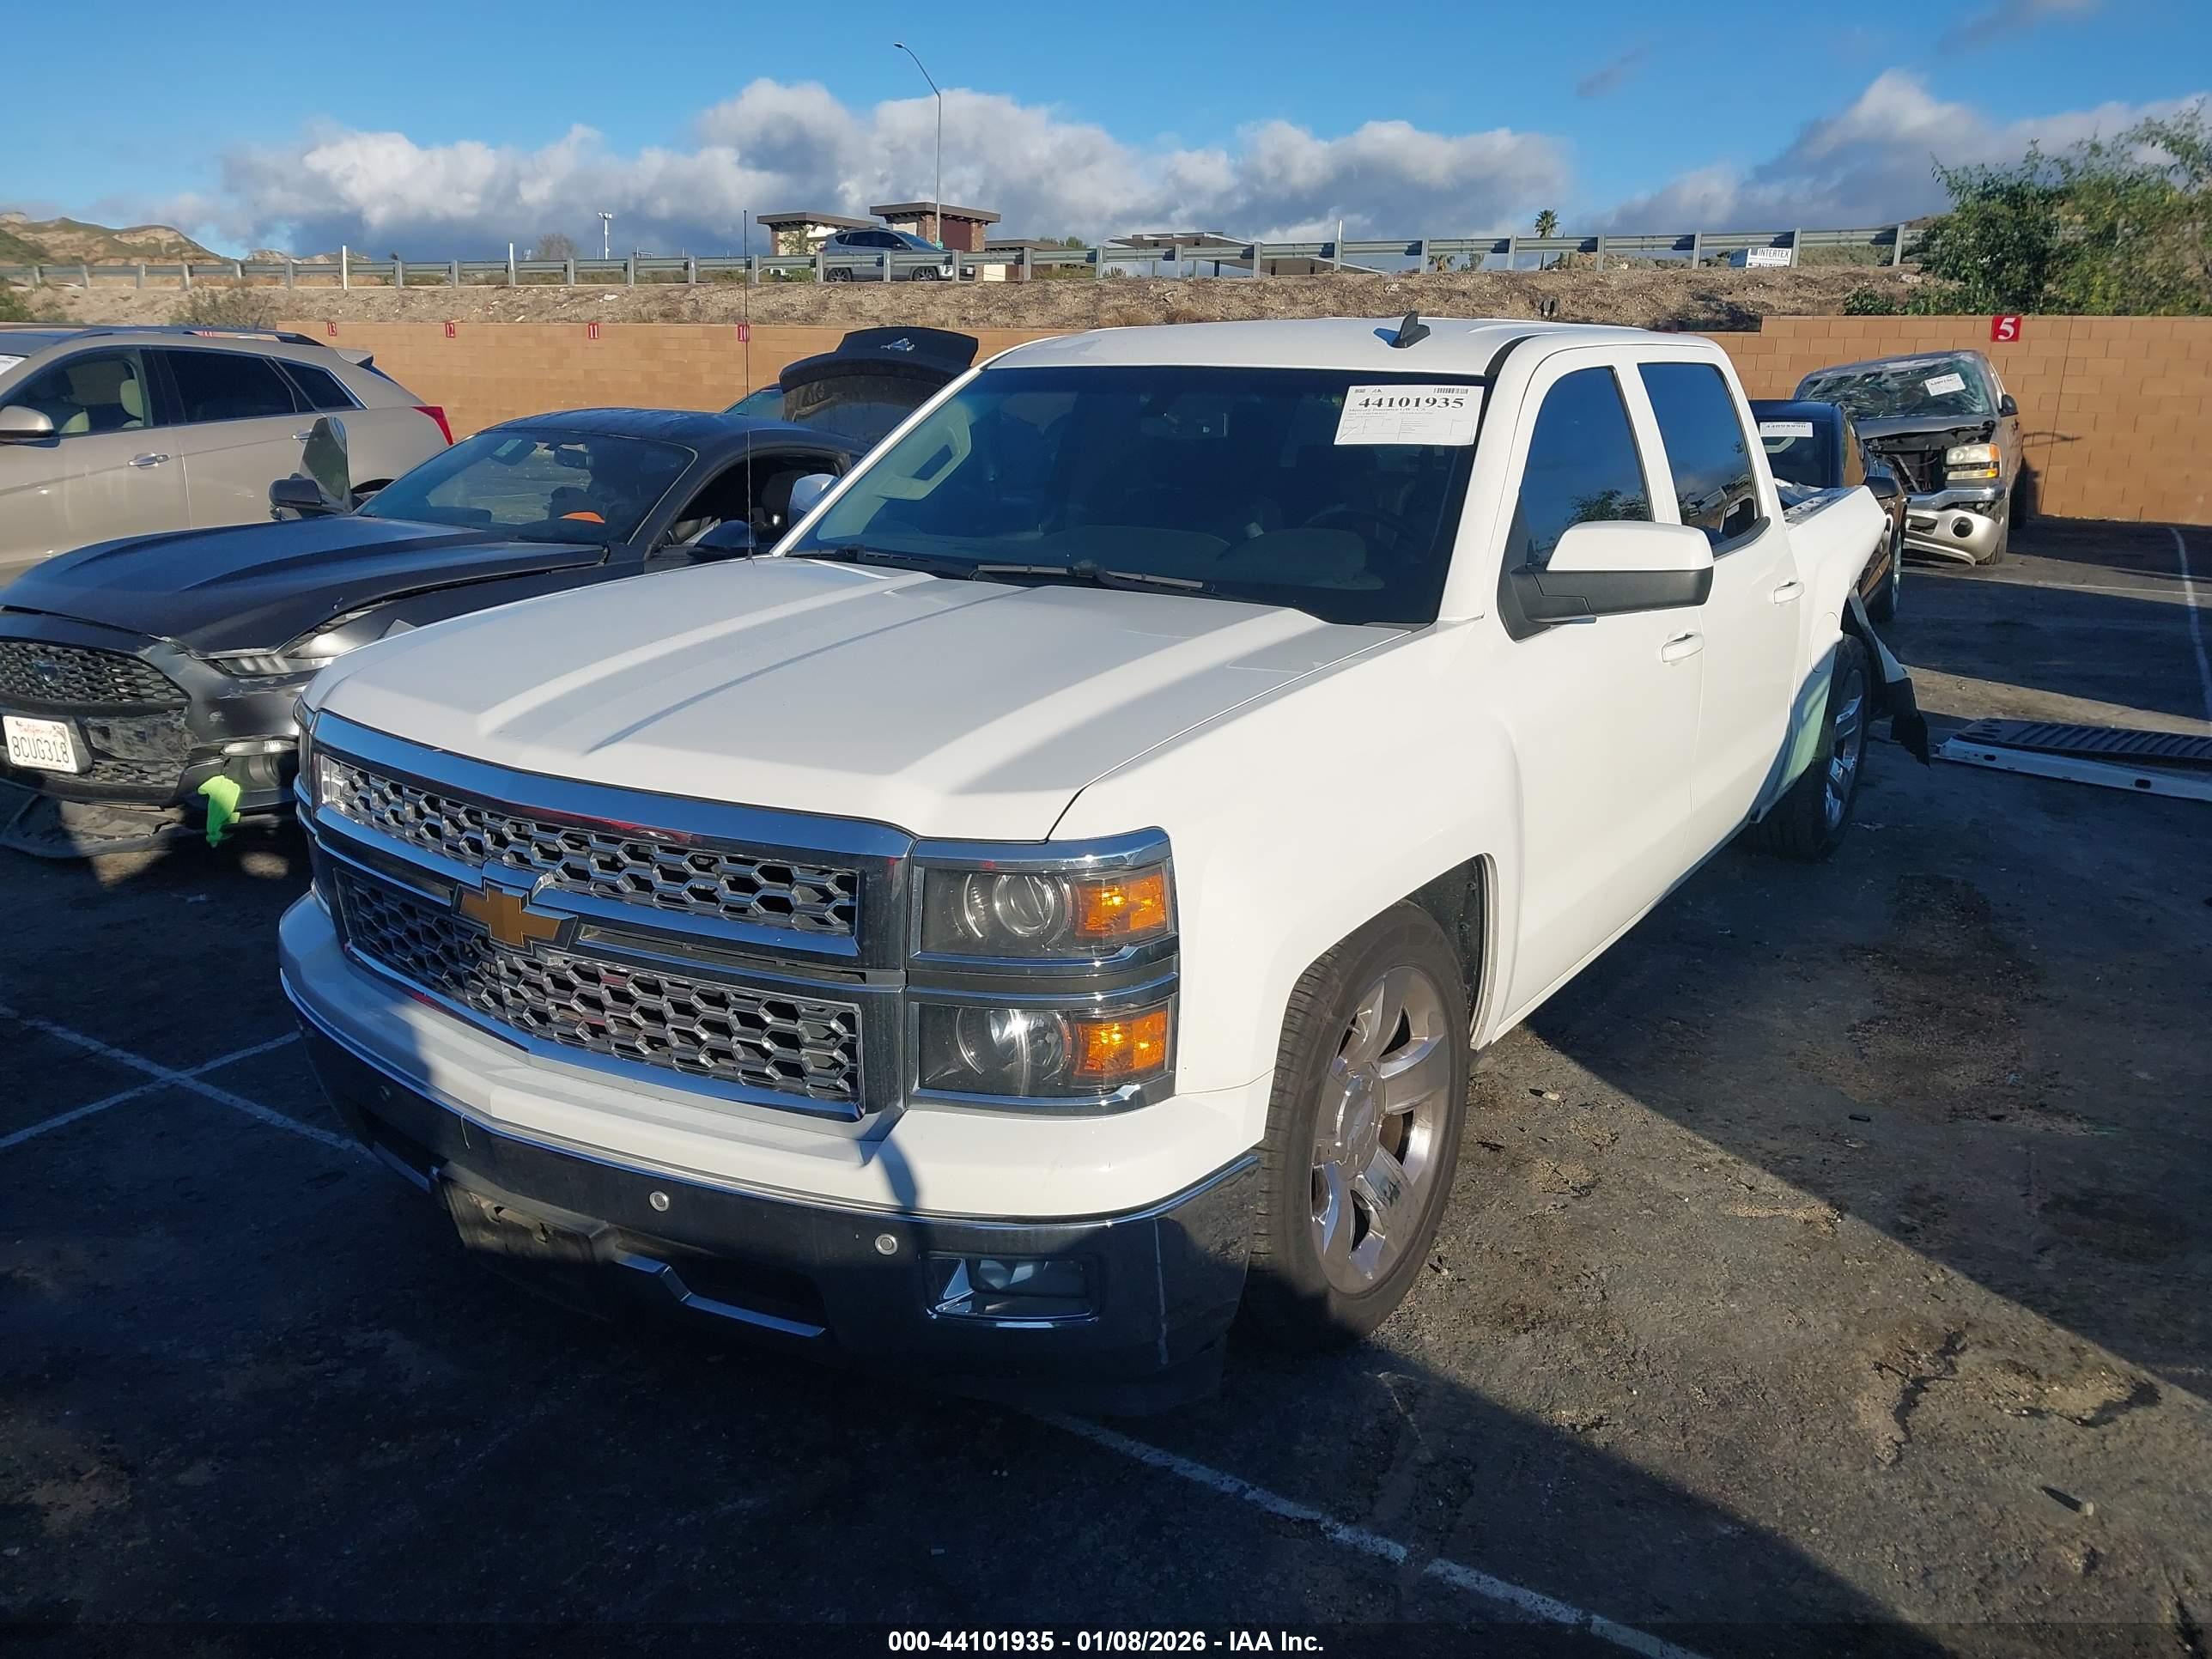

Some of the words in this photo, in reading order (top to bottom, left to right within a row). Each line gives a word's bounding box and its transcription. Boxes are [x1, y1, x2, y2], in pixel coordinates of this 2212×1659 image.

[1759, 248, 1790, 258] INTERTEX
[328, 323, 337, 336] 13
[447, 324, 455, 337] 12
[589, 325, 599, 338] 11
[738, 326, 749, 341] 10
[1997, 318, 2016, 340] 5
[1358, 397, 1465, 409] 44101935
[11, 736, 70, 763] 8CUG318
